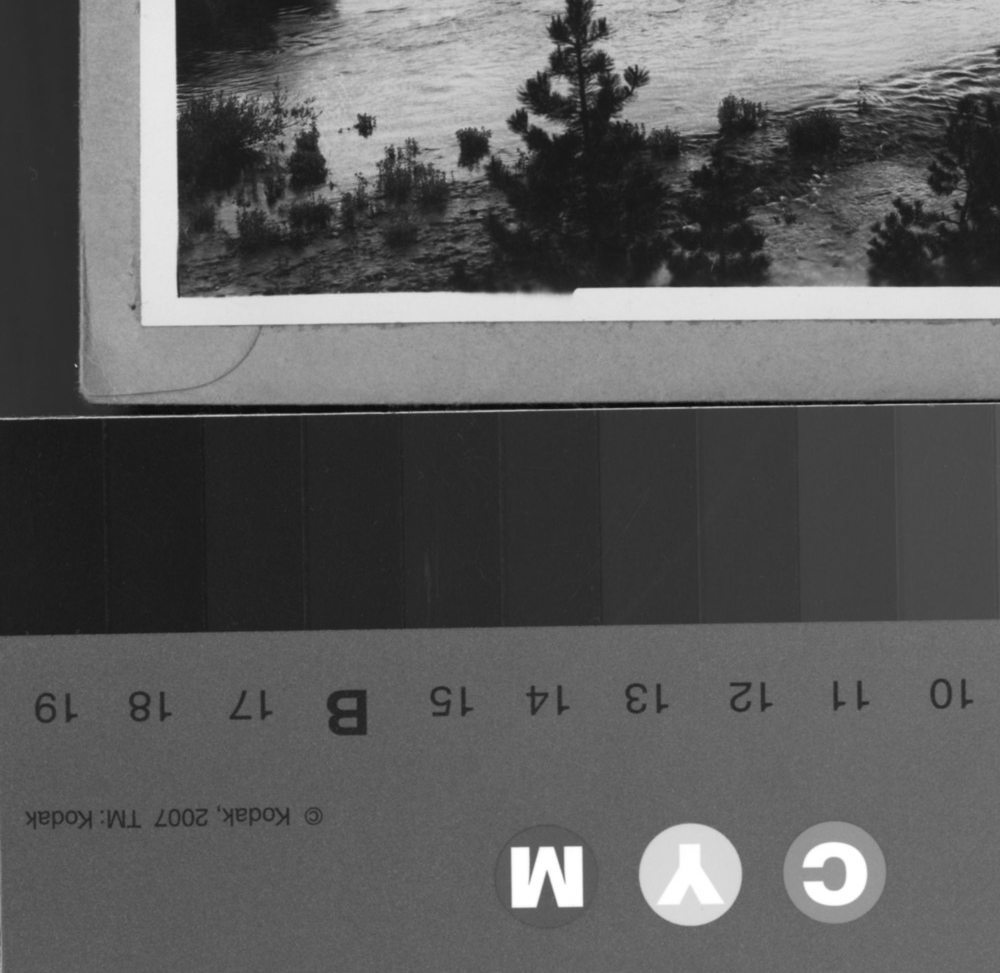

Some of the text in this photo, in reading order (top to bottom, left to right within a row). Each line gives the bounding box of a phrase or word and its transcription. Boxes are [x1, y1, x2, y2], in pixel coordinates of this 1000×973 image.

[34, 692, 78, 723] 19
[129, 691, 172, 722] 18
[229, 690, 273, 721] 17
[430, 686, 474, 717] 15
[526, 684, 570, 715] 14
[625, 683, 669, 714] 13
[729, 681, 773, 713] 12
[832, 680, 870, 711] 11
[930, 678, 974, 709] 10
[327, 689, 368, 736] B
[24, 809, 92, 830] Kodak
[98, 808, 140, 829] TM:
[154, 807, 208, 828] 2007
[216, 804, 290, 827] Kodak,
[510, 842, 867, 909] C Y M
